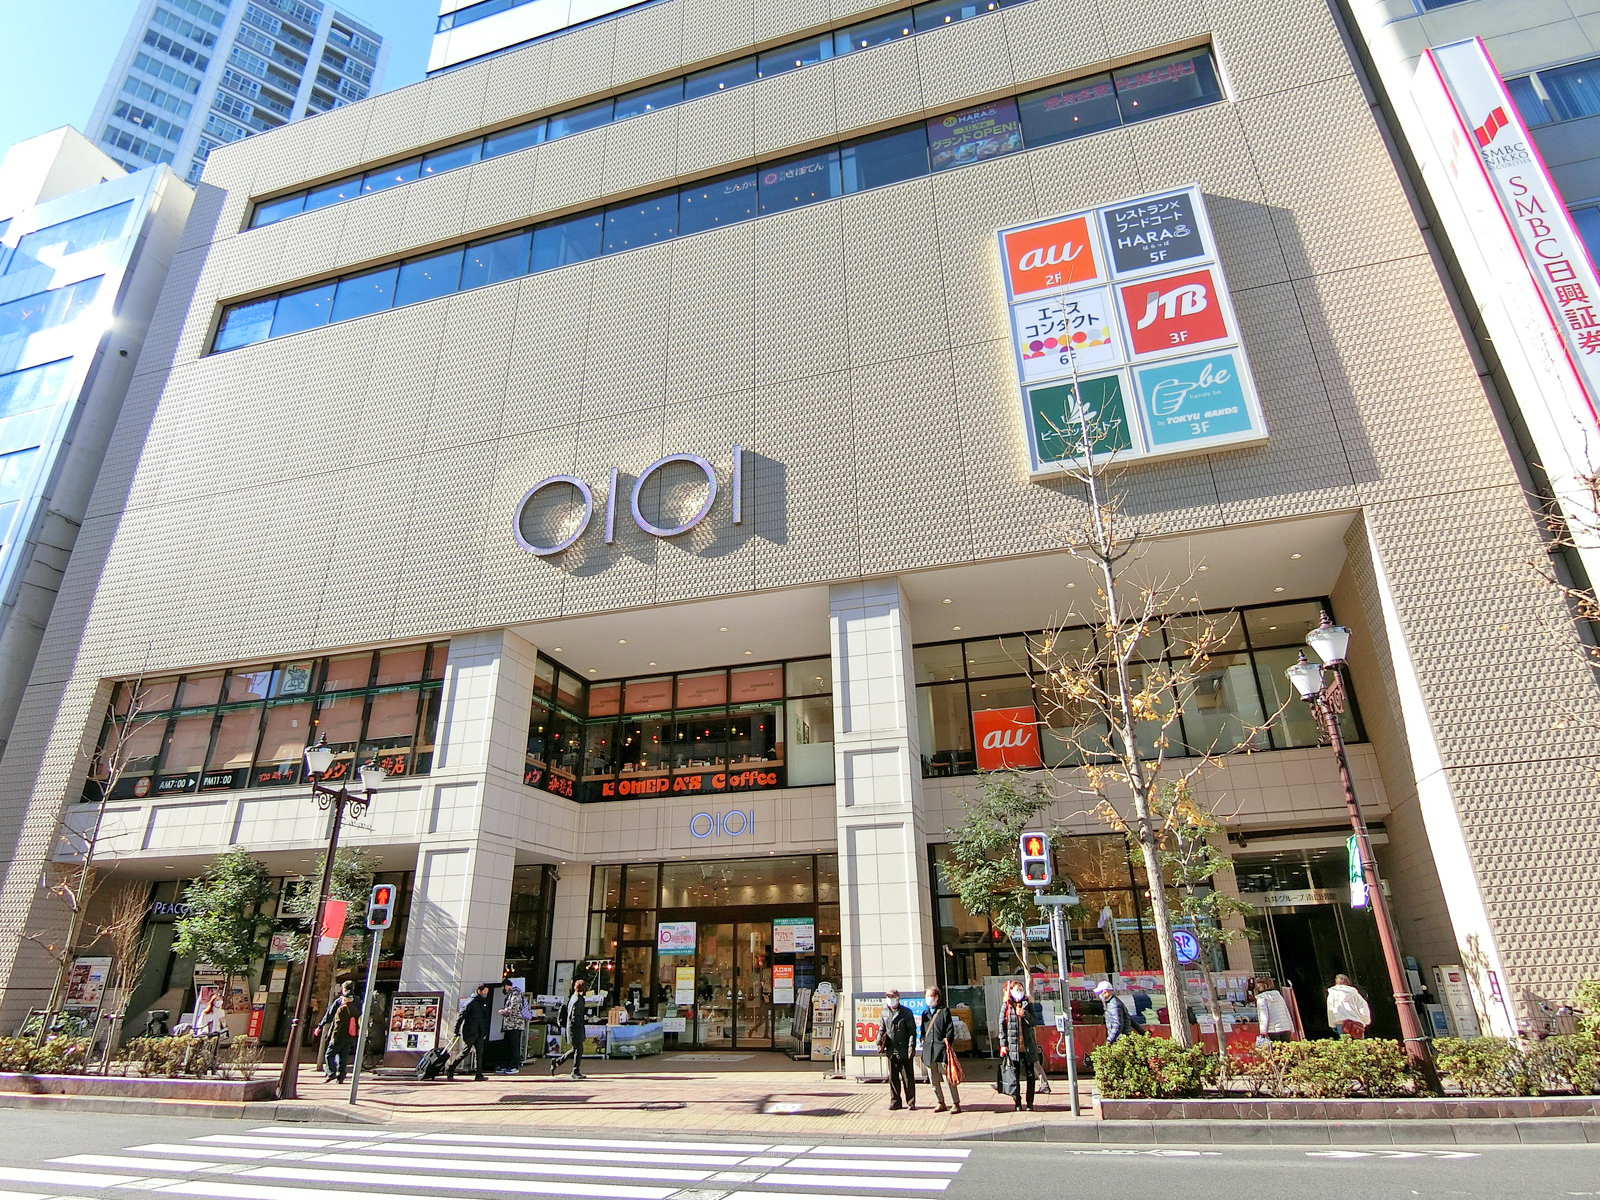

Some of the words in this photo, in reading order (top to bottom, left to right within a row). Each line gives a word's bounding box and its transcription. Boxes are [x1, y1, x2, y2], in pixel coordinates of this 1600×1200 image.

[1481, 142, 1526, 159] SMBC
[1485, 151, 1529, 166] NIKKO
[1116, 211, 1183, 233] フードコート
[1018, 241, 1084, 271] au
[1149, 249, 1168, 263] 5F
[1508, 175, 1600, 356] SMBC日興証券
[1045, 272, 1062, 285] 2F
[1038, 302, 1080, 321] エース
[1136, 283, 1208, 331] JTB
[1025, 313, 1100, 338] コンタクト
[1169, 330, 1189, 344] 3F
[1198, 362, 1231, 388] be
[1166, 412, 1201, 425] TOKYU
[1204, 405, 1239, 418] HANDS
[1189, 420, 1210, 435] 3F
[982, 728, 1032, 750] au
[158, 778, 187, 790] AM7:00
[203, 774, 232, 786] PM11:00
[711, 770, 778, 789] Coffee
